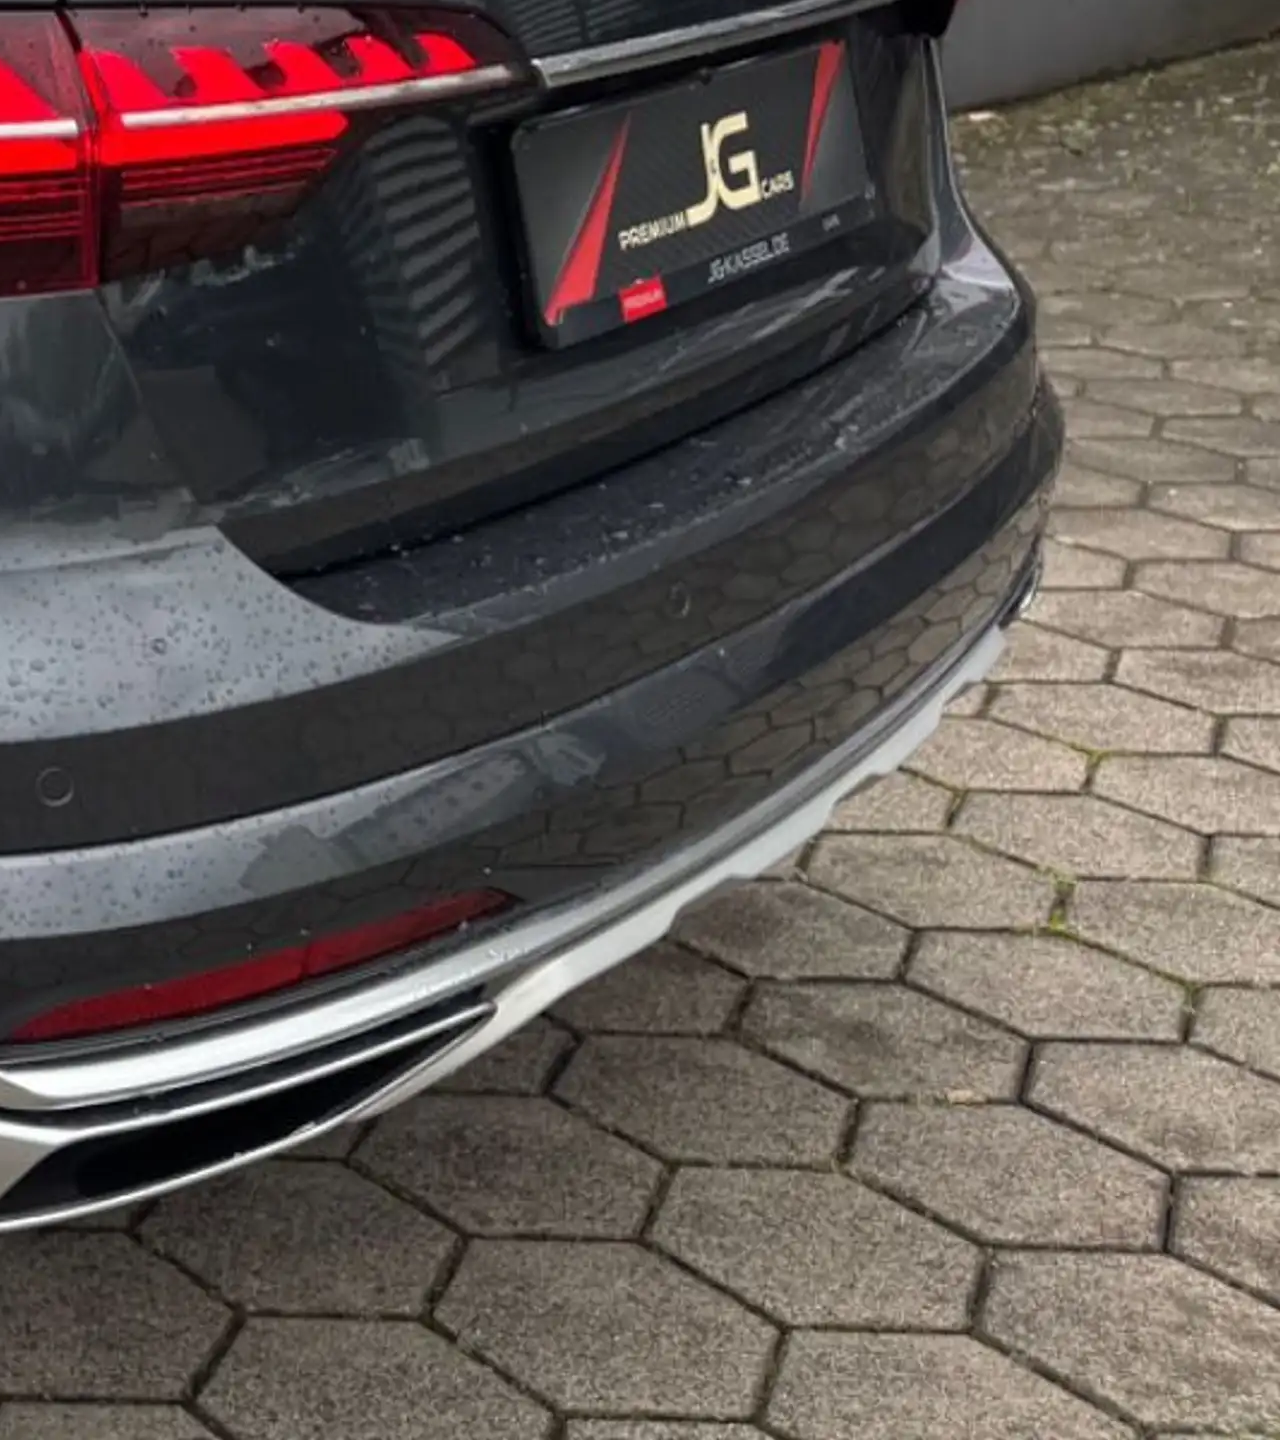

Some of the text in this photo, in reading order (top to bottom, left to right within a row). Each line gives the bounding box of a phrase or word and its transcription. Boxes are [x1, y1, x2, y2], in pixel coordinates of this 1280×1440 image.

[618, 111, 794, 250] PREMIUM JG CARS
